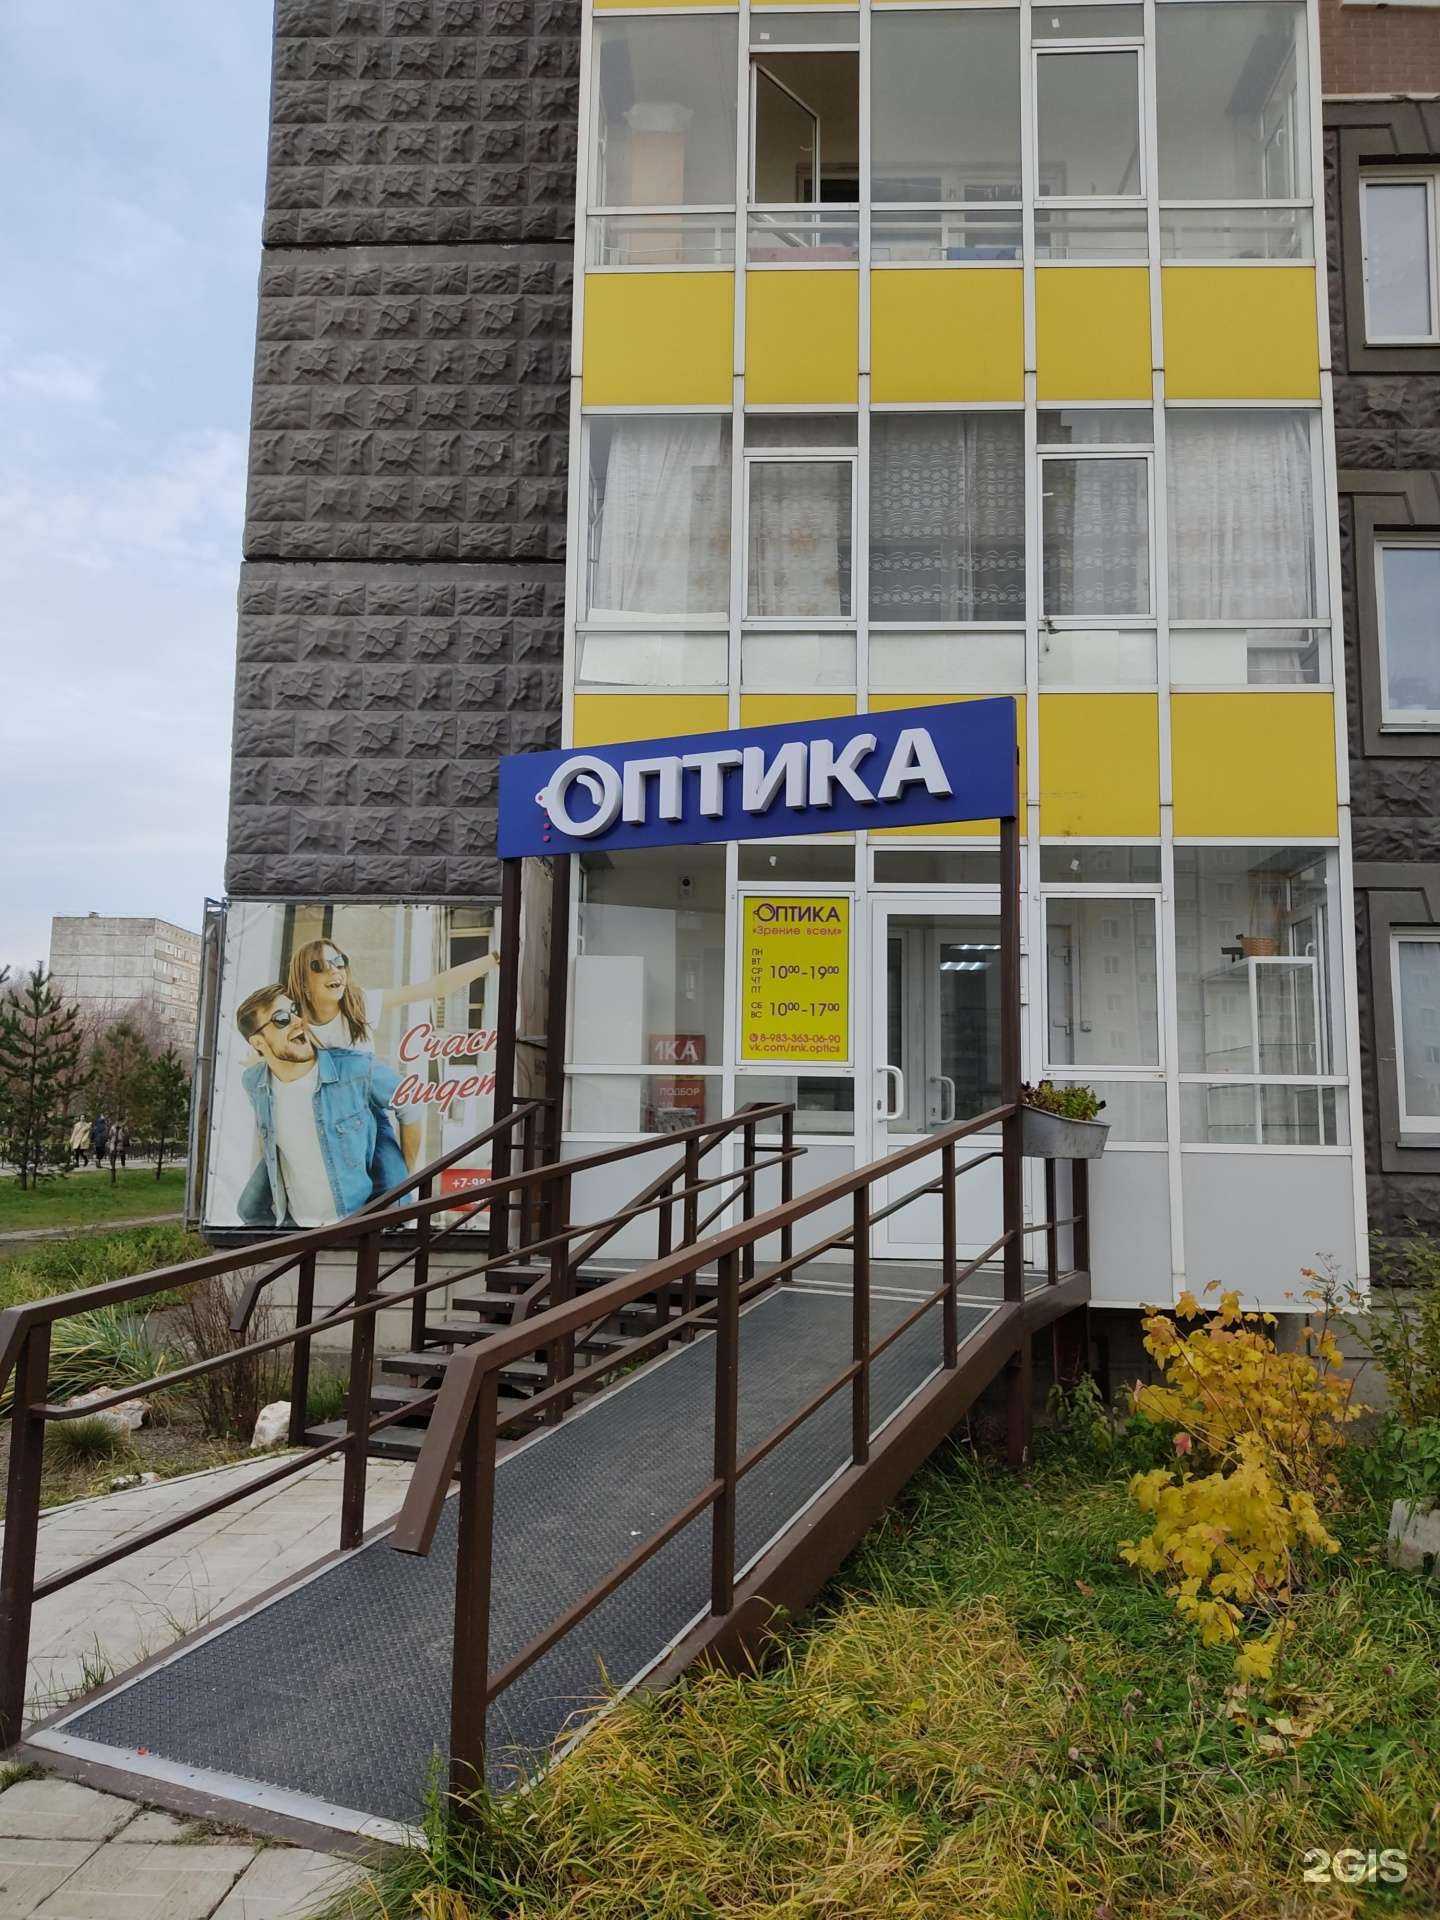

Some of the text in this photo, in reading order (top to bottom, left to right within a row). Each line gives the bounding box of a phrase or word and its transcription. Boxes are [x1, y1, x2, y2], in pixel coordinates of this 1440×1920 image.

[538, 727, 954, 838] ОПТИКА
[754, 903, 841, 922] ОПТИКА
[751, 948, 763, 956] ПН
[751, 957, 761, 965] ВТ
[751, 967, 763, 975] СР
[659, 1087, 701, 1097] ПОДБОР
